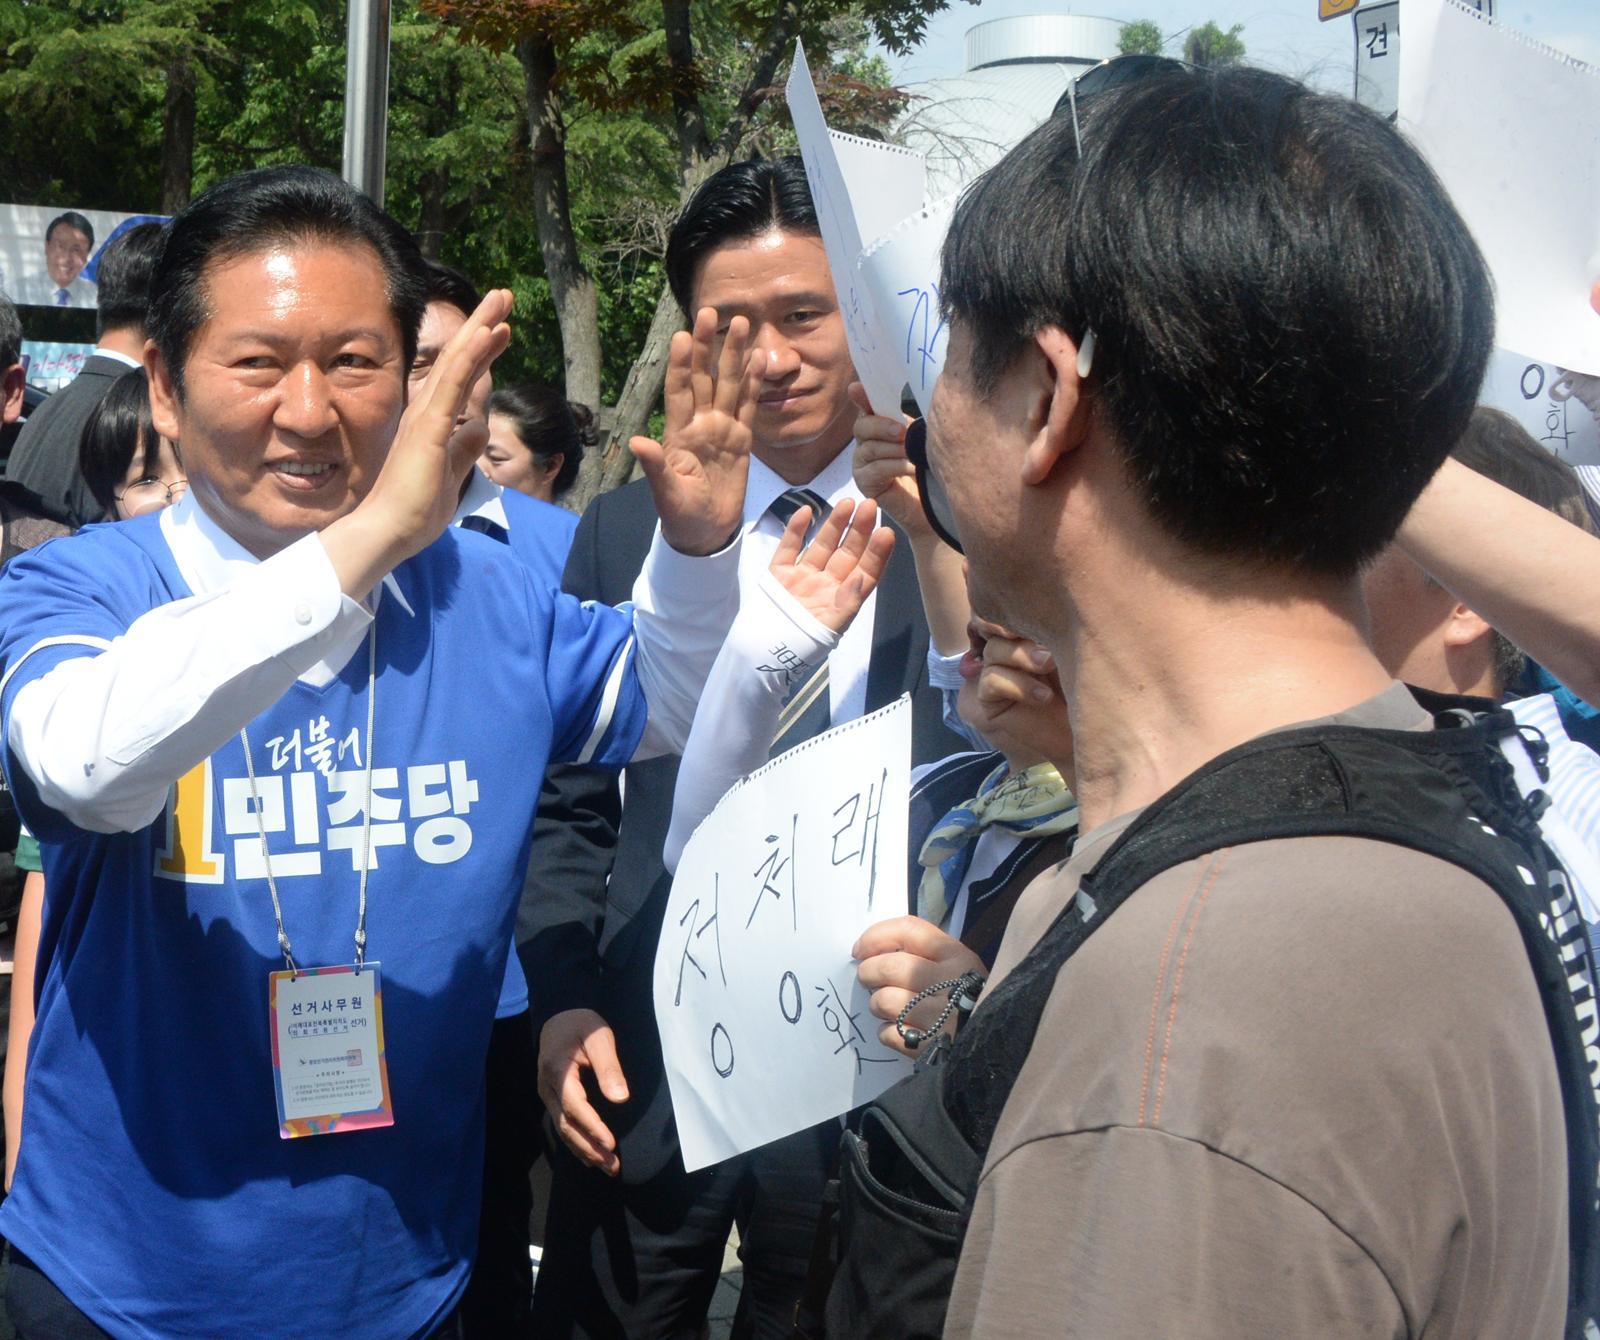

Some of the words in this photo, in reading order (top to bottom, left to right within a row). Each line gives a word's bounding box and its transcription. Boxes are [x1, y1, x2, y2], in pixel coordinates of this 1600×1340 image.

[265, 715, 363, 776] 더불어
[153, 756, 225, 885] 1
[223, 759, 479, 880] 민주당
[291, 996, 362, 1016] 선거사무원
